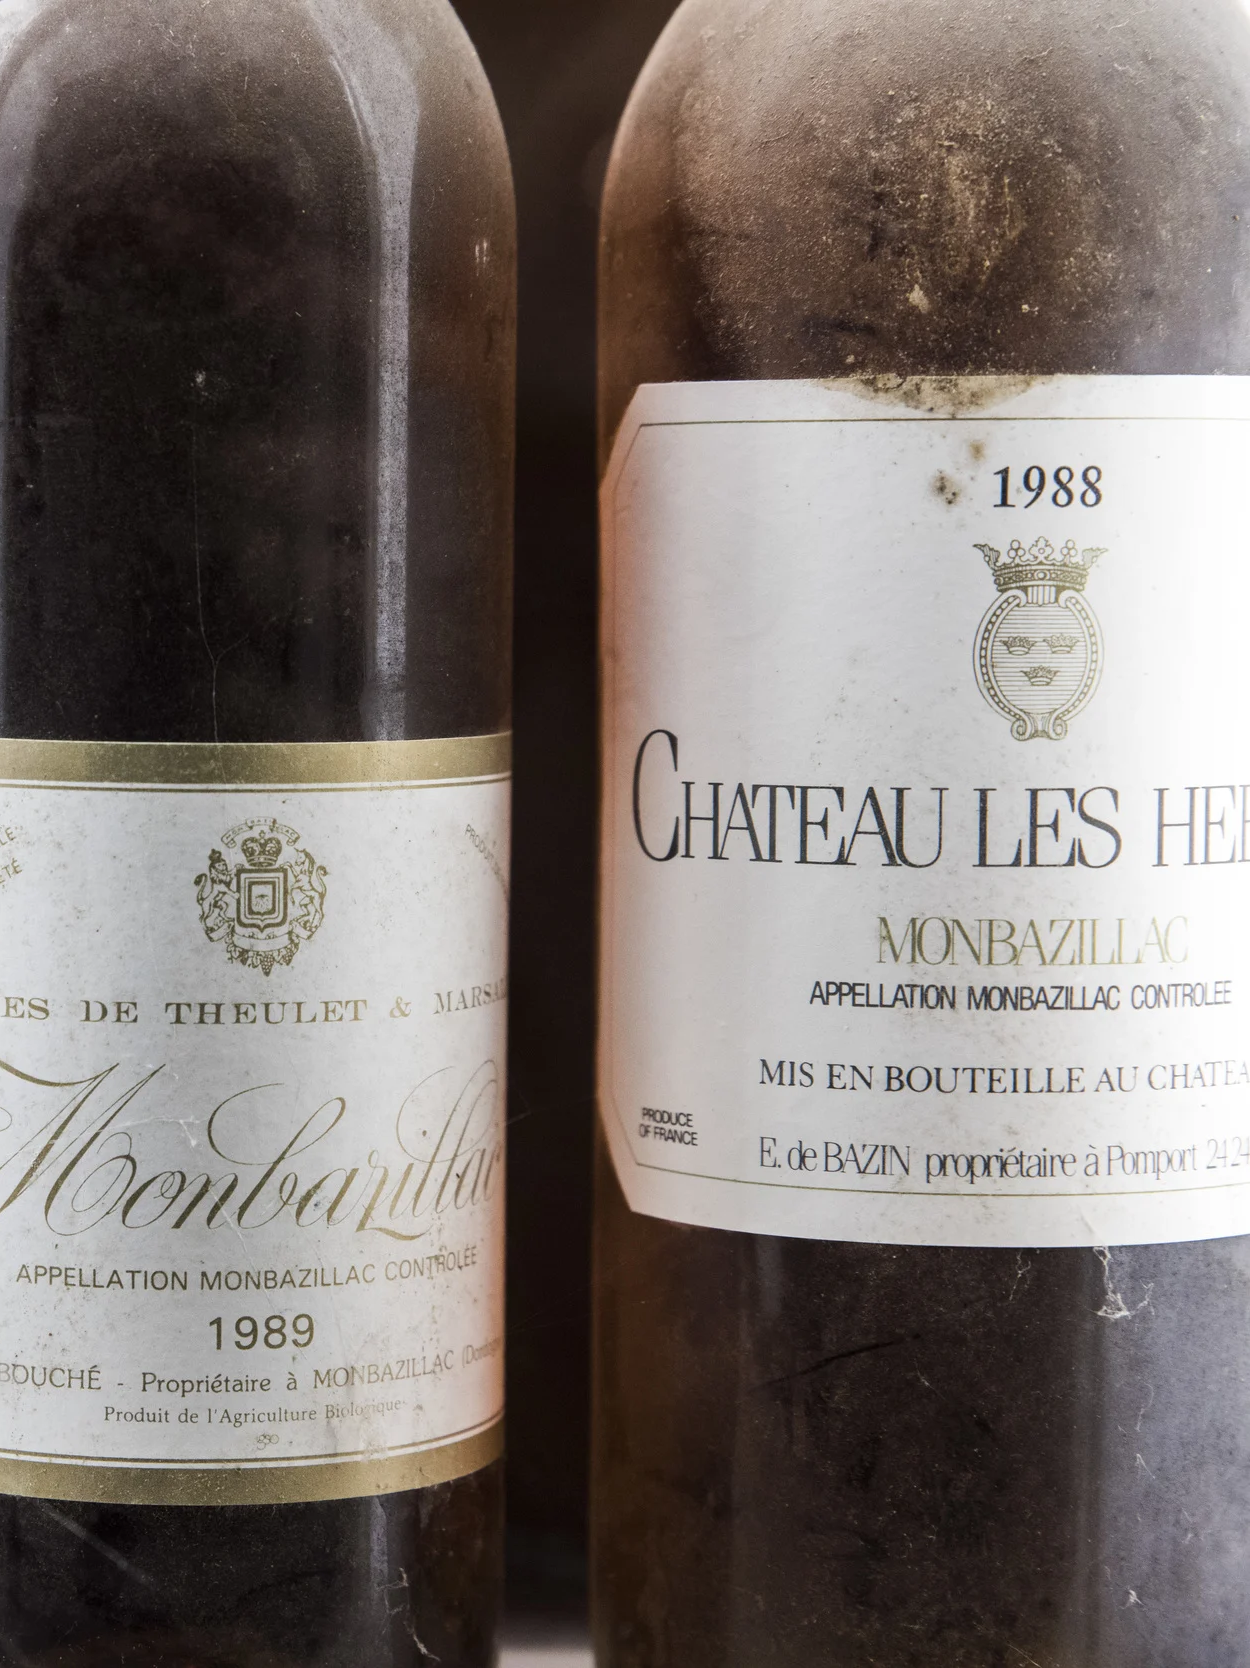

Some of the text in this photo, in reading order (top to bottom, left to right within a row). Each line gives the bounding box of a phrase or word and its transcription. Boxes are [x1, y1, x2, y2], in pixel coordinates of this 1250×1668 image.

[992, 465, 1104, 508] 1988
[632, 729, 949, 868] CHATEAU
[972, 786, 1122, 868] LES
[877, 916, 1188, 967] MONBAZILLAC
[81, 1000, 139, 1023] DE
[165, 999, 368, 1024] THEULET
[389, 996, 412, 1018] &
[810, 980, 1232, 1012] APPELLATION MONBAZILLAC CONTROLEE
[759, 1059, 814, 1088] MIS
[827, 1063, 874, 1091] EN
[884, 1066, 1086, 1094] BOUTEILLE
[1095, 1066, 1138, 1093] AU
[639, 1124, 698, 1146] OF FRANCE
[642, 1107, 693, 1128] PRODUCE
[759, 1136, 782, 1169] E.
[788, 1141, 817, 1171] de
[824, 1142, 910, 1177] BAZIN
[926, 1147, 1076, 1184] propriétaire
[1084, 1145, 1099, 1176] à
[1106, 1143, 1197, 1180] Pomport
[16, 1263, 188, 1292] APPELLATION
[200, 1264, 376, 1291] MONBAZILLAC
[208, 1313, 315, 1351] 1989
[140, 1371, 271, 1399] Propriétaire
[286, 1370, 298, 1391] à
[313, 1350, 454, 1390] MONBAZILLAC
[104, 1406, 170, 1424] Produit
[178, 1406, 199, 1424] de
[207, 1407, 317, 1428] l'Agriculture
